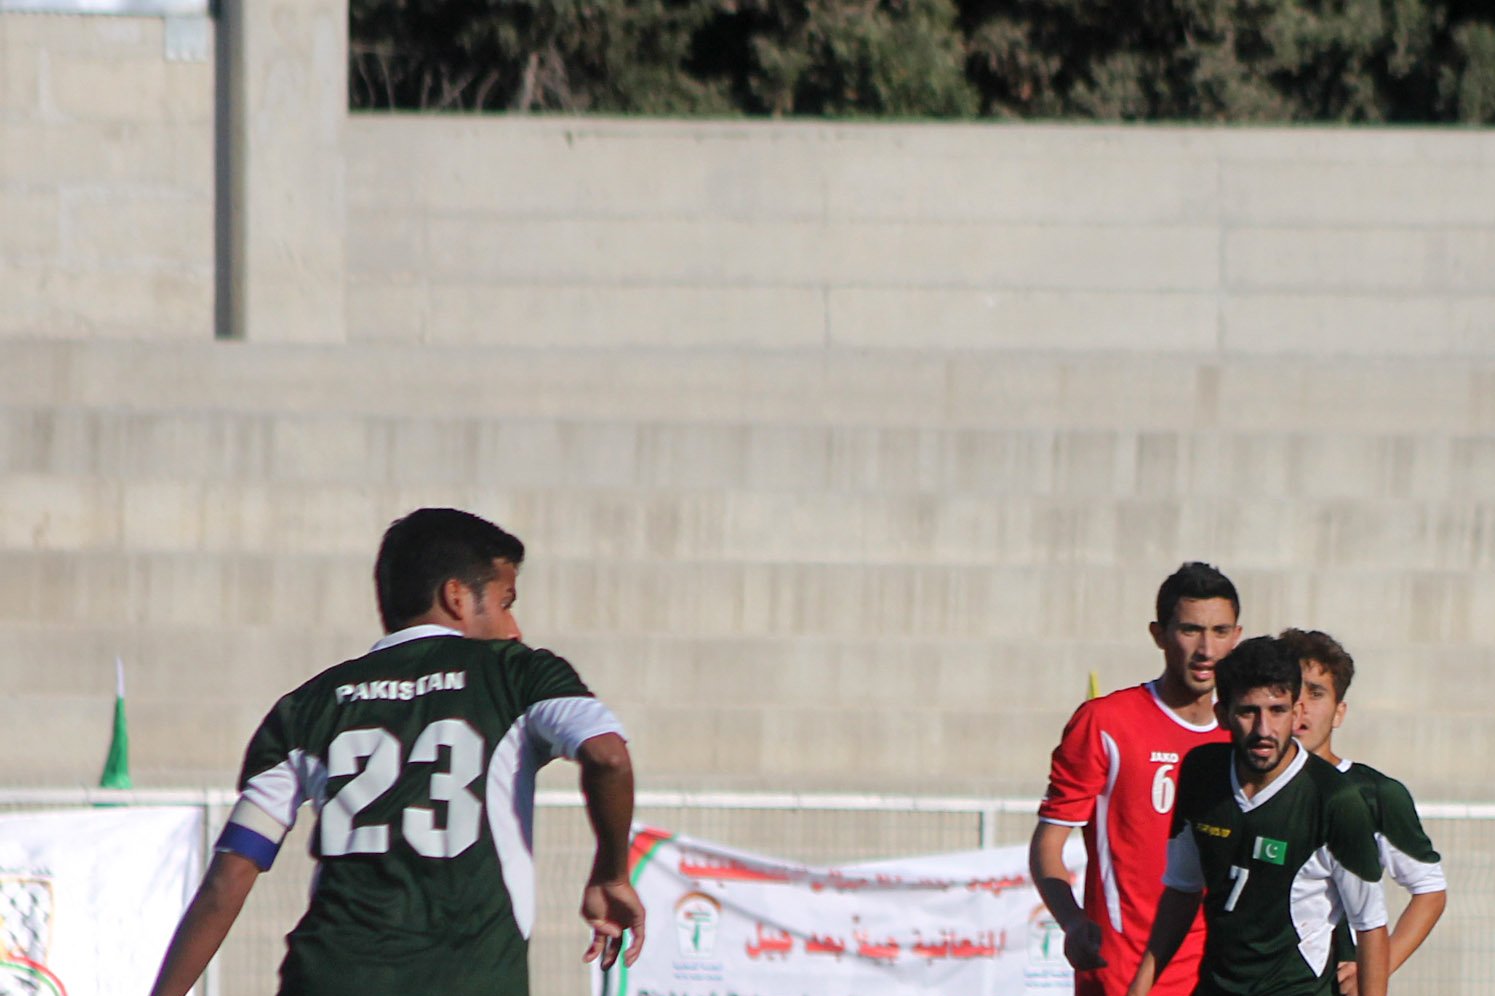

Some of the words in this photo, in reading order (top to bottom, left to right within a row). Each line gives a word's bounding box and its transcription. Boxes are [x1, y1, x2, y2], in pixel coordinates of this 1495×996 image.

[336, 670, 466, 704] PAKISTAN
[320, 718, 485, 859] 23
[1151, 763, 1176, 814] 6
[1223, 864, 1250, 913] 7
